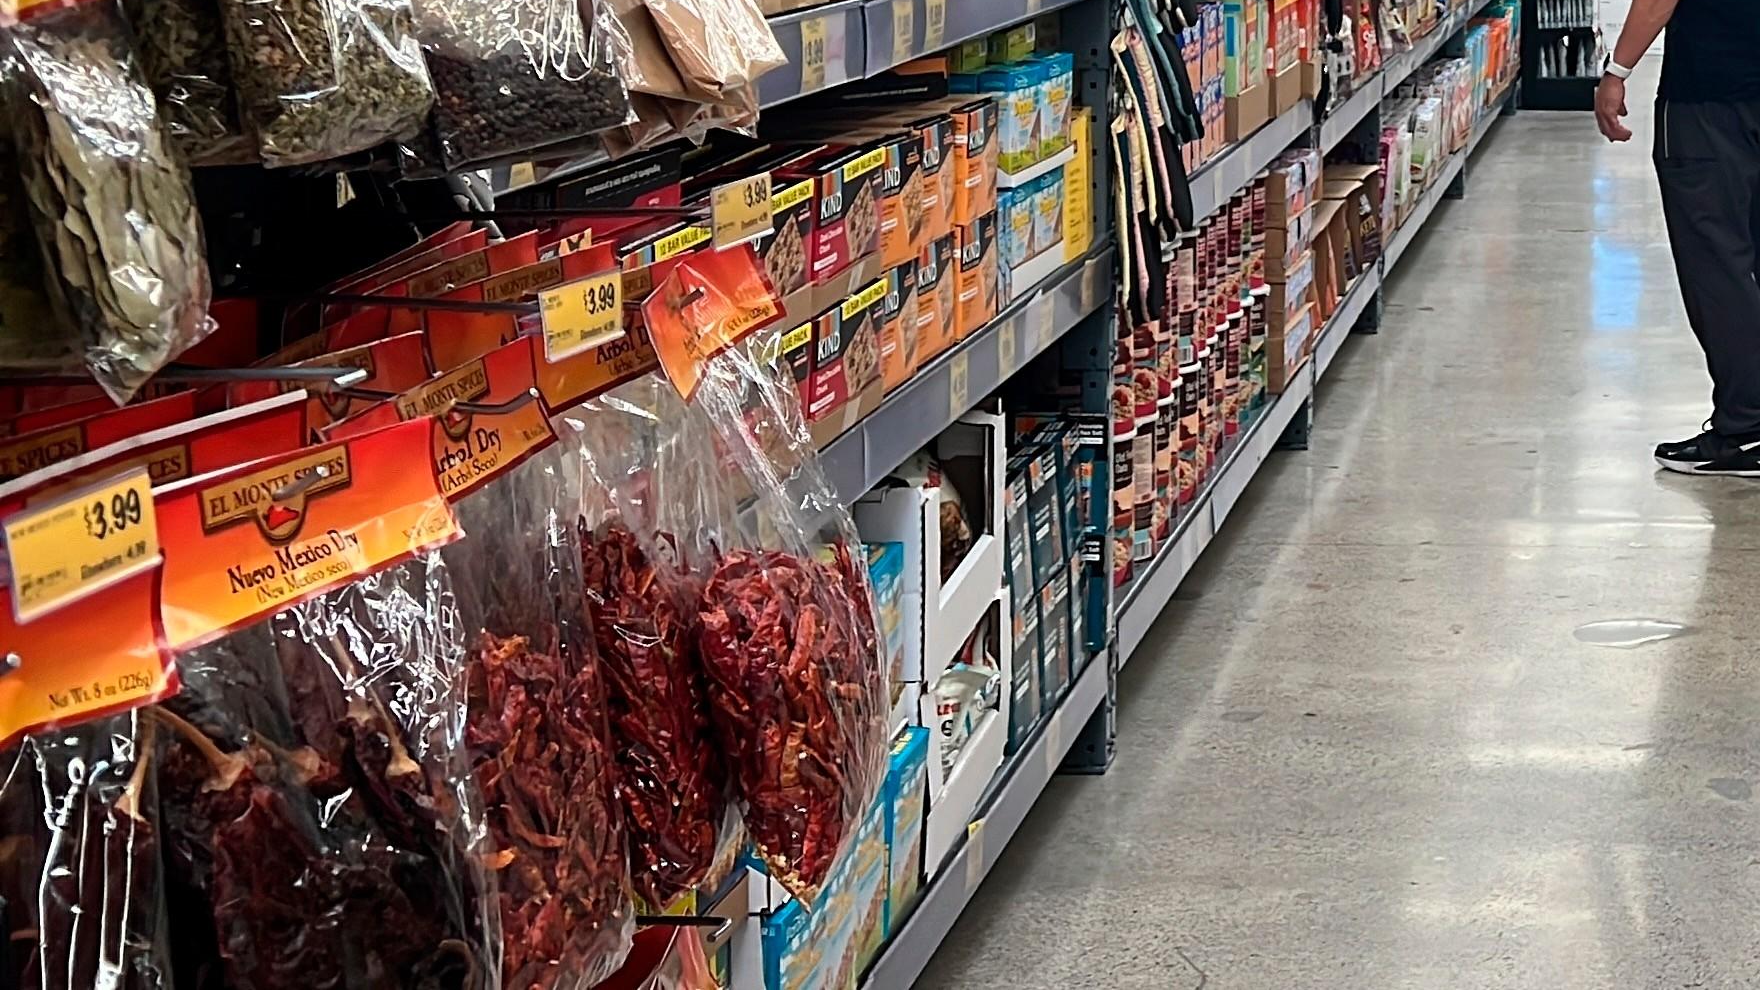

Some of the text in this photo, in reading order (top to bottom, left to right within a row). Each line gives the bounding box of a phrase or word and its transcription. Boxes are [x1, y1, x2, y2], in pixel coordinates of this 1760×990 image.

[884, 167, 901, 190] IND
[744, 179, 767, 208] $3.99
[820, 194, 843, 221] KIND
[583, 282, 615, 315] $3.99
[884, 290, 900, 314] IND
[818, 334, 841, 361] KIND
[438, 442, 472, 474] rbol
[477, 428, 502, 454] Dry
[209, 495, 230, 517] EL
[232, 476, 290, 508] MONTE
[84, 488, 141, 540] $3.99
[227, 565, 276, 594] Nuevo
[275, 543, 331, 576] Mexico
[94, 683, 101, 700] 8
